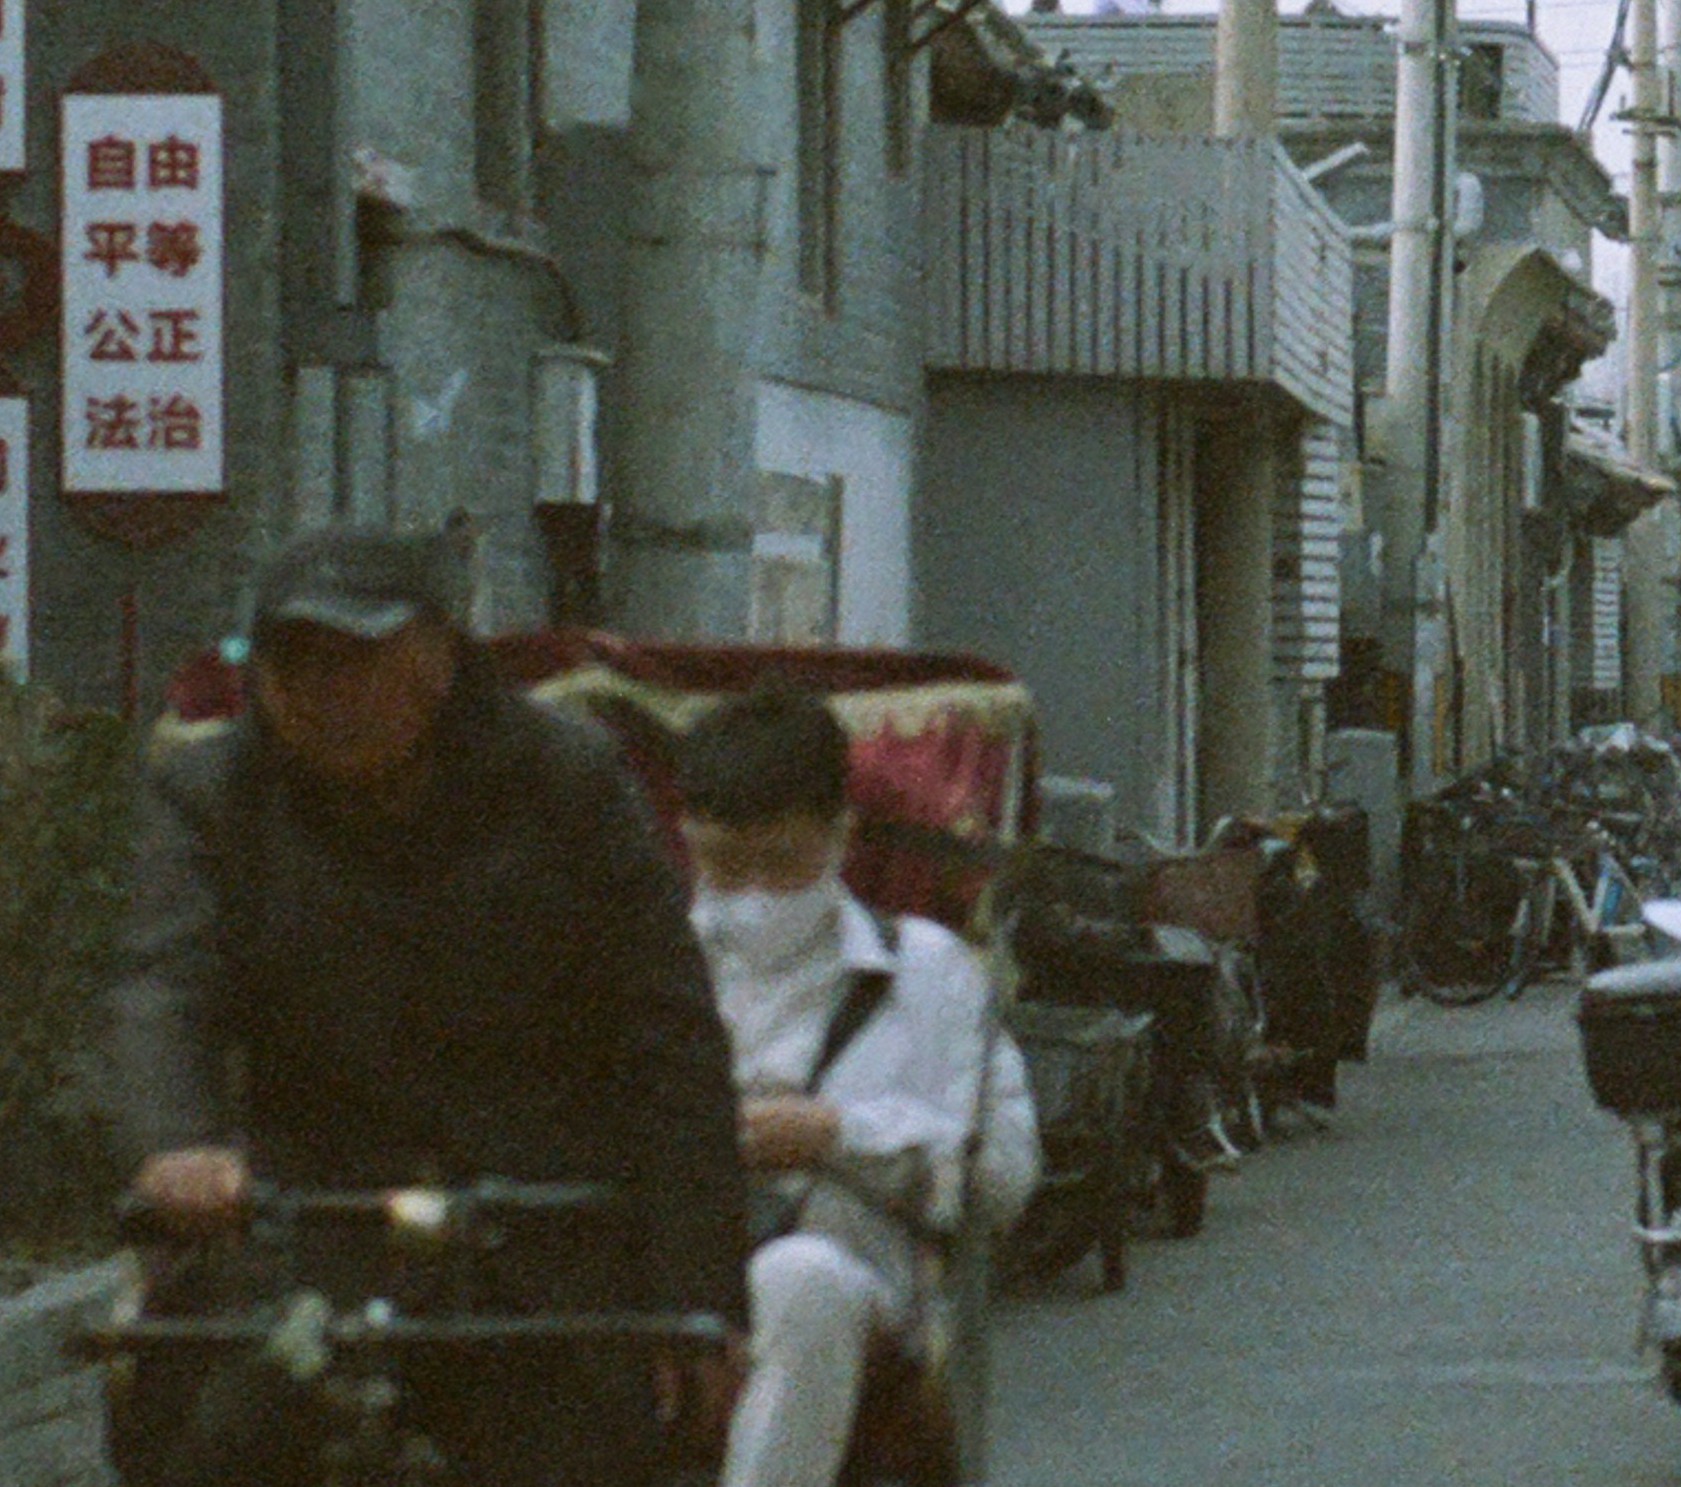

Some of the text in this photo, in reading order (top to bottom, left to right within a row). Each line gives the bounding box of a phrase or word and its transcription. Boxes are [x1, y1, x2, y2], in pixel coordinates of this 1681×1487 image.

[86, 134, 199, 191] 自由
[84, 220, 201, 277] 平等
[84, 309, 201, 364] 公正
[84, 394, 201, 451] 法治
